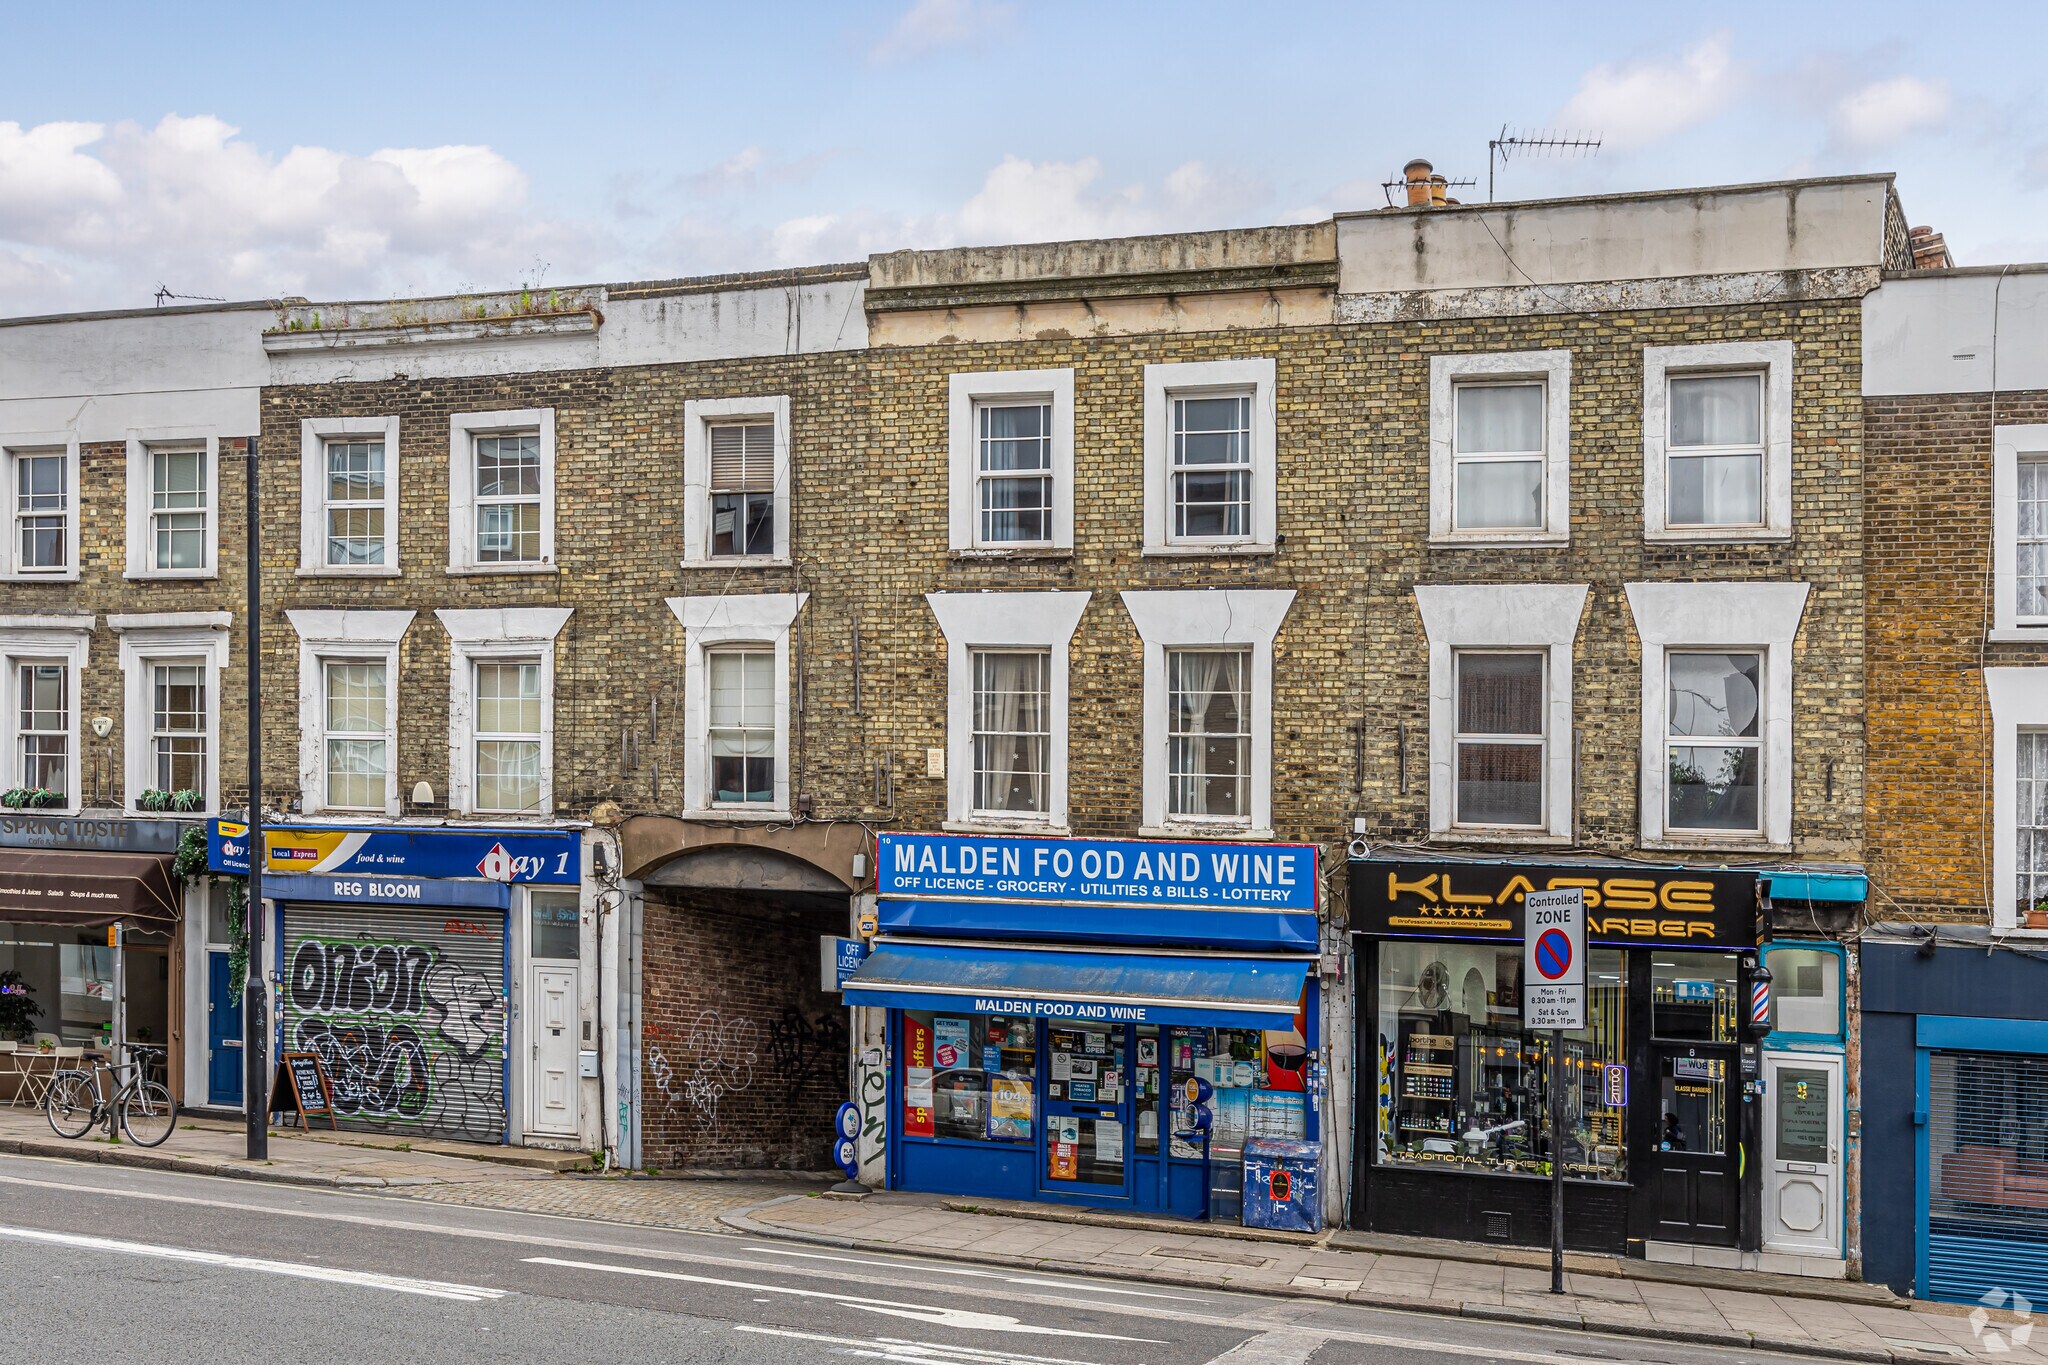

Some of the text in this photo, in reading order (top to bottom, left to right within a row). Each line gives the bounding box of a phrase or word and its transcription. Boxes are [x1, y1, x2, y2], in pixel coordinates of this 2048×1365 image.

[3, 820, 129, 838] SPRING TASTE
[882, 837, 891, 845] 10
[293, 850, 317, 858] Express
[356, 853, 405, 865] food & wine
[484, 852, 569, 881] day 1
[895, 844, 1296, 886] MALDEN FOOD AND WINE
[70, 890, 85, 898] Soups
[334, 881, 421, 899] REG BLOOM
[894, 877, 921, 888] OFF
[925, 877, 985, 891] LICENCE
[996, 880, 1067, 893] GROCERY
[1080, 883, 1148, 897] UTILITIES
[1152, 886, 1163, 897] &
[1167, 886, 1209, 899] BILLS
[1222, 888, 1292, 902] LOTTERY
[1387, 872, 1715, 912] KLASSE
[1529, 893, 1579, 908] Controlled
[1535, 909, 1571, 924] ZONE
[1588, 917, 1715, 939] ARBER
[845, 943, 859, 956] OFF
[838, 955, 863, 969] LICENC
[1540, 988, 1554, 996] Mon
[975, 999, 1146, 1020] MALDEN FOOD AND WINE
[1538, 1008, 1549, 1016] Sat
[1550, 1008, 1555, 1016] &
[1531, 1017, 1546, 1025] 9.30
[913, 1028, 925, 1068] offers
[1085, 1046, 1105, 1054] OPEN
[1689, 1048, 1695, 1057] 8
[1611, 1067, 1621, 1104] OPEN
[1396, 1151, 1483, 1164] TRADITIONAL
[1561, 1164, 1609, 1173] ARBER
